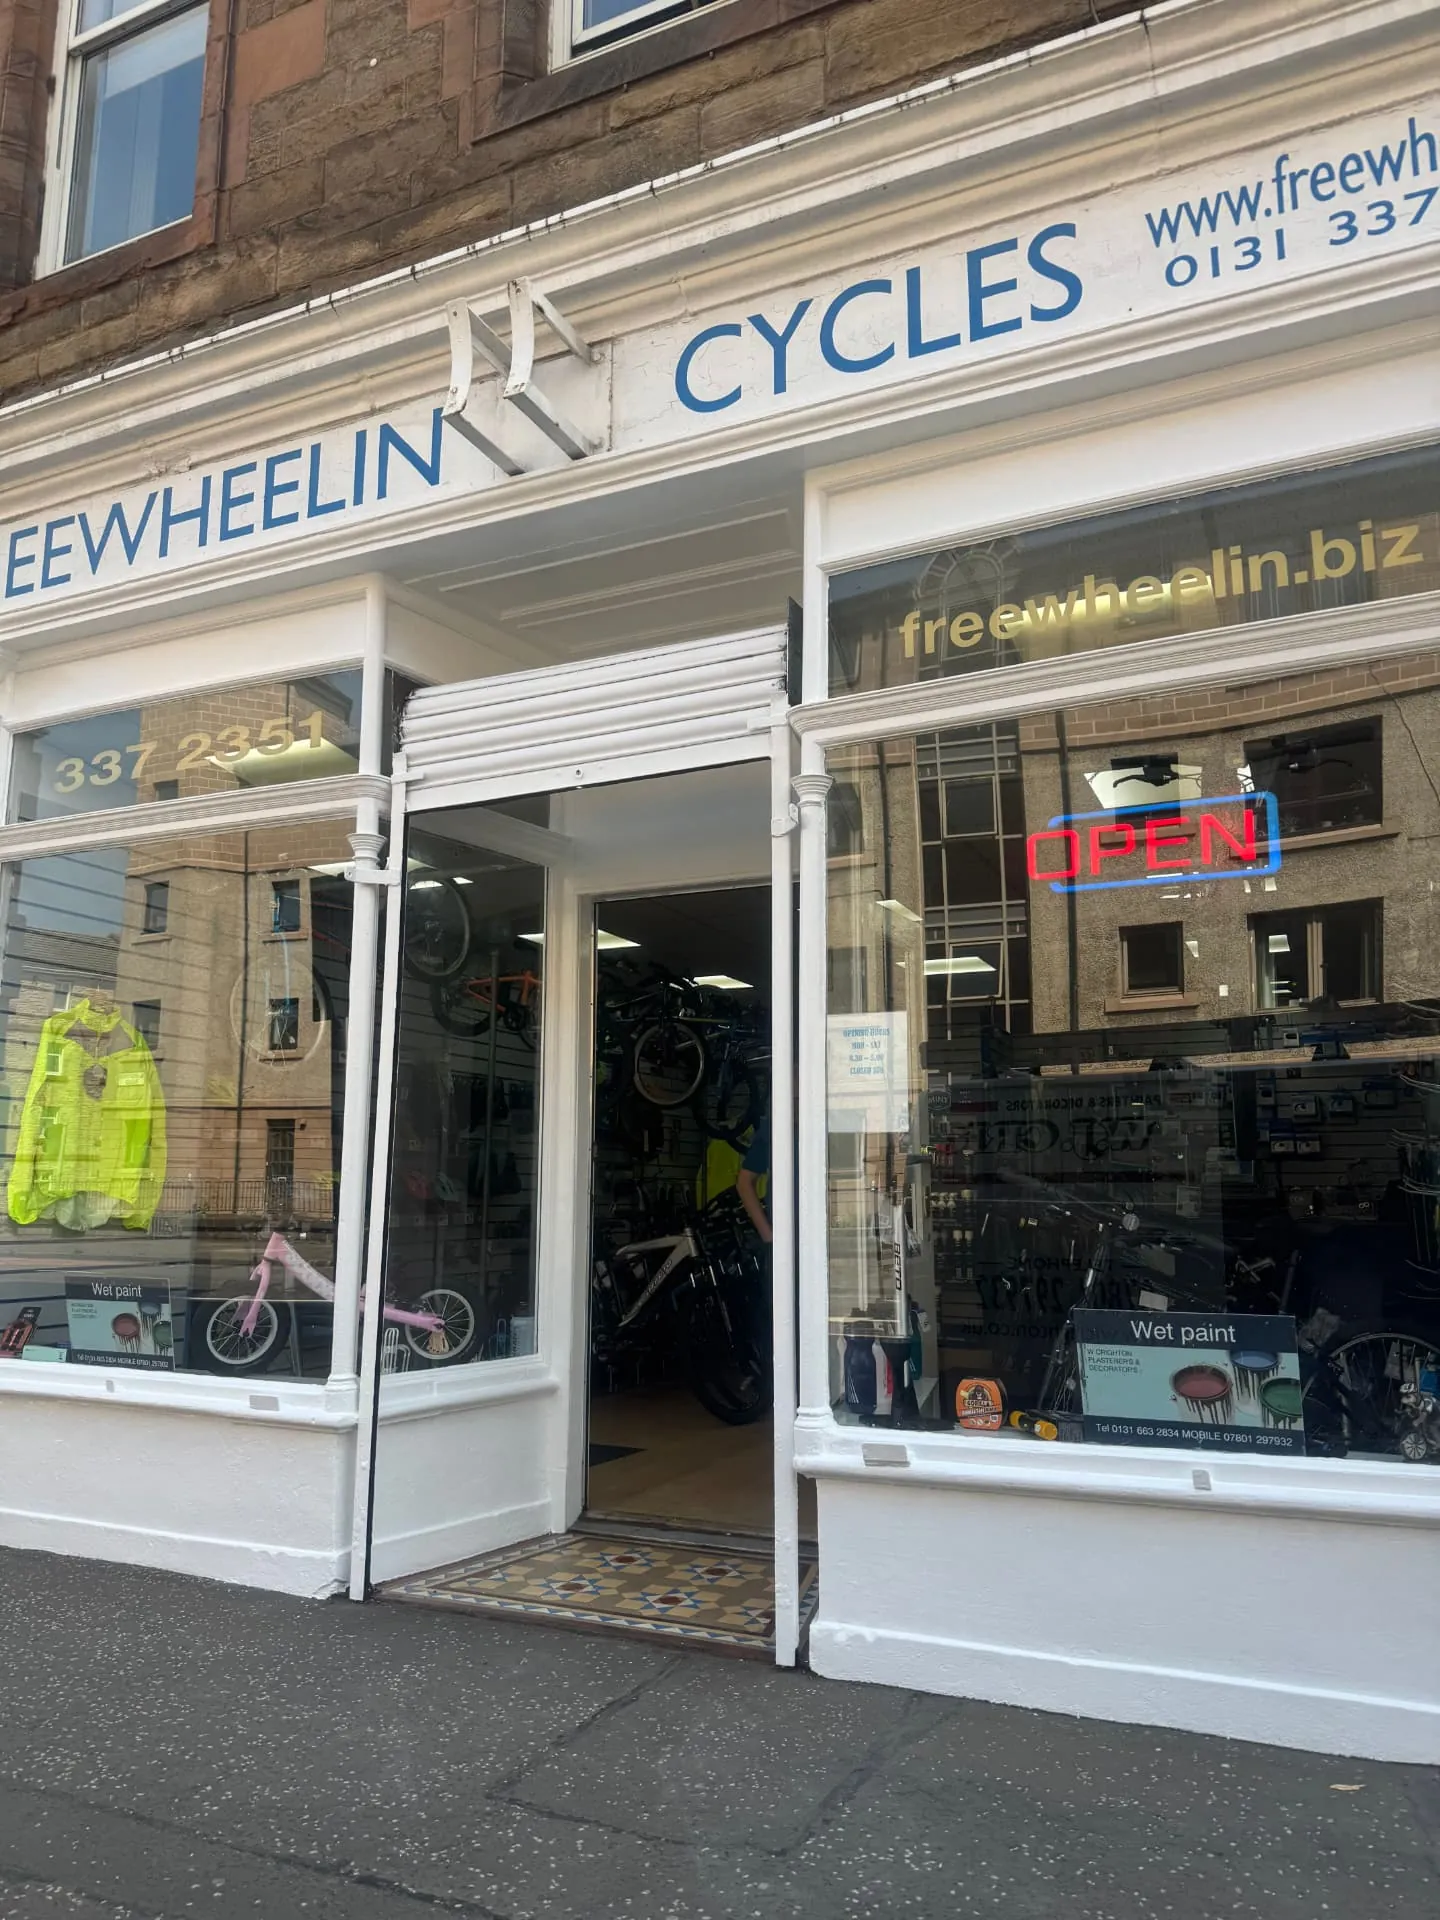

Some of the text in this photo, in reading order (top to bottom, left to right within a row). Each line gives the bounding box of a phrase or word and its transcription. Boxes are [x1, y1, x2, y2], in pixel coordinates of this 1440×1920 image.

[1145, 117, 1438, 248] www.freewh
[1165, 187, 1440, 288] 0131 337
[4, 222, 1084, 597] EEWHEELIN CYCLES
[898, 520, 1424, 659] freewheelin.biz
[54, 710, 324, 795] 337 2351
[1027, 808, 1257, 880] OPEN
[92, 1282, 142, 1300] Wet paint
[1130, 1319, 1237, 1345] Wet paint
[1095, 1423, 1293, 1446] Tel 0131 663 2834 MOBILE 07801 297932
